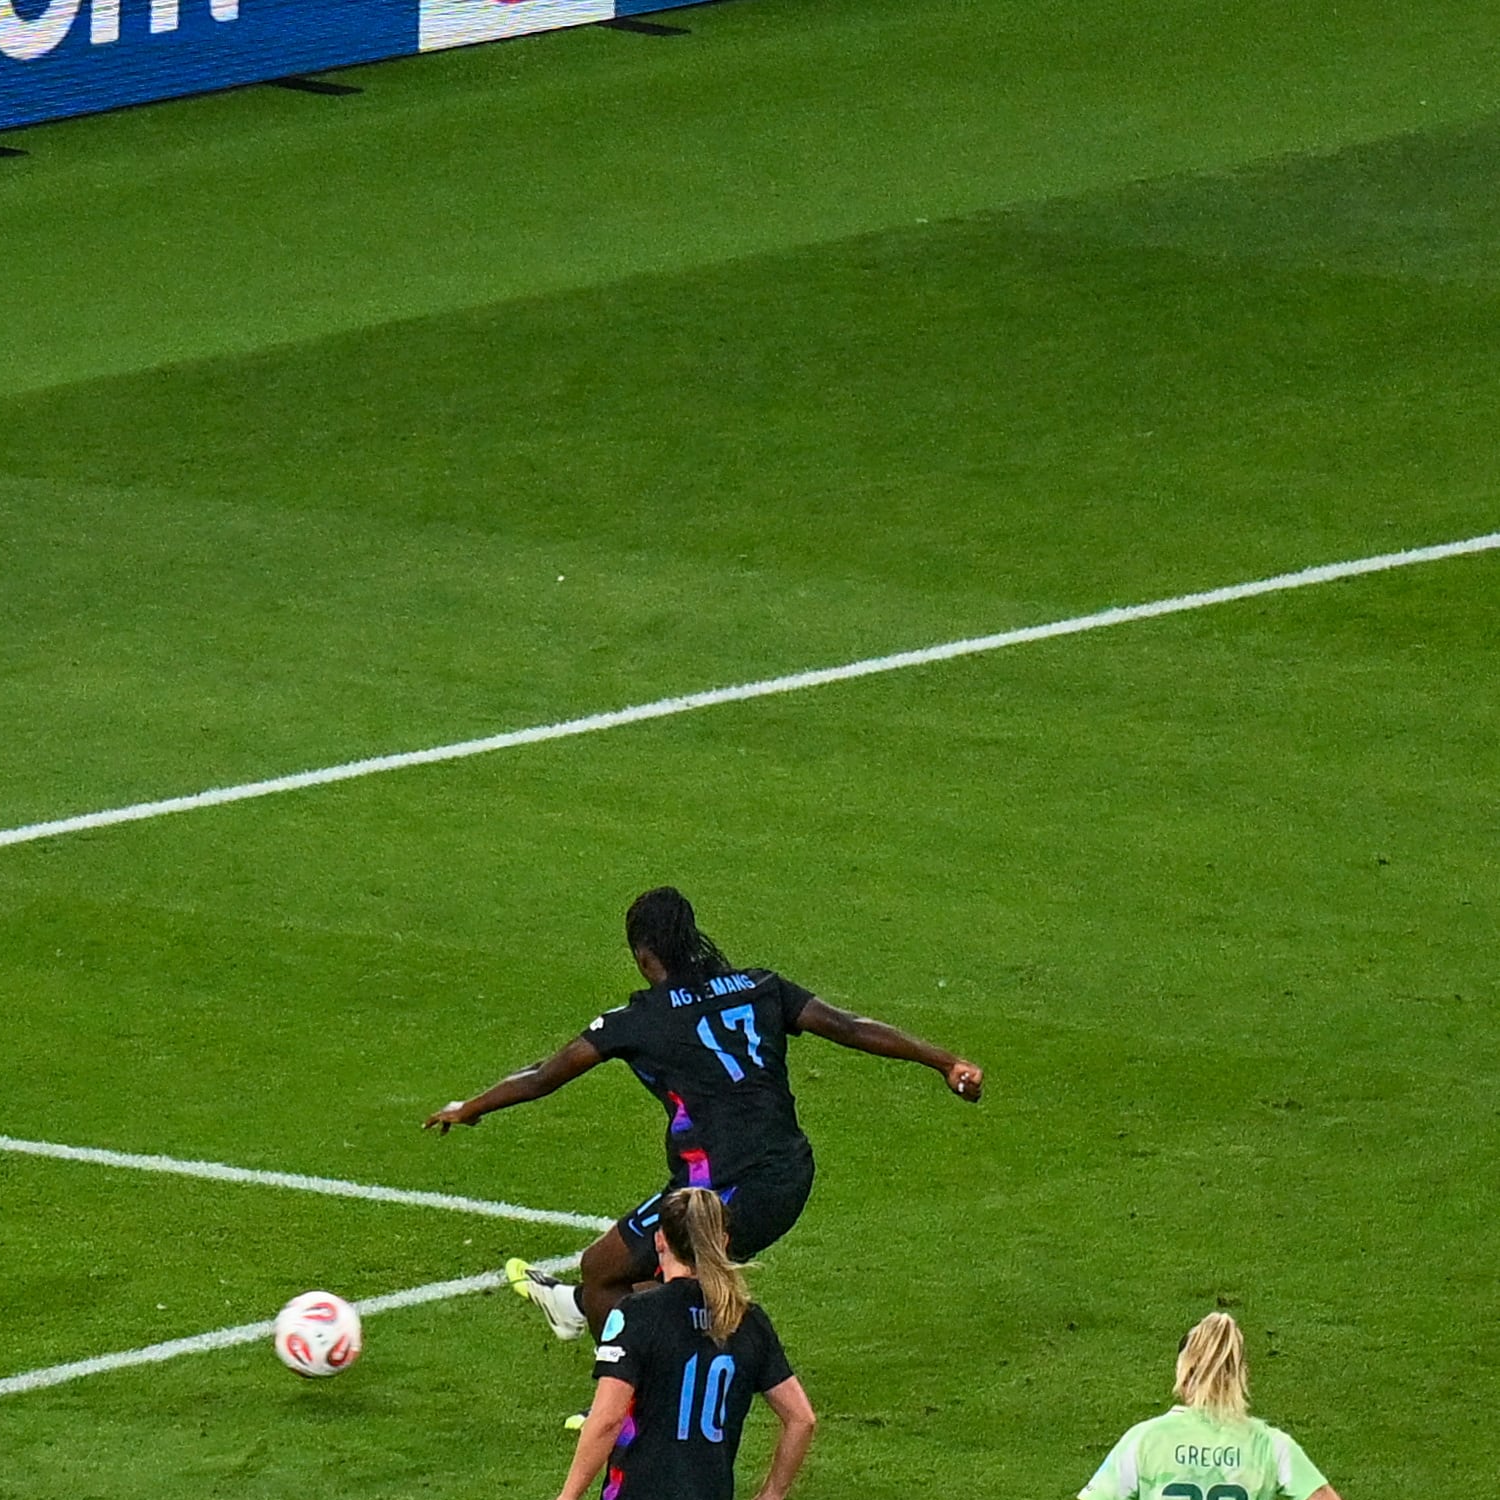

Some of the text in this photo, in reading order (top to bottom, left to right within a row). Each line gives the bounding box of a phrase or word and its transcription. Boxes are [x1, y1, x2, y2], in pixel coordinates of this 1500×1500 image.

[696, 1003, 764, 1083] 17
[677, 1352, 735, 1443] 10
[1175, 1444, 1240, 1468] GREGGI
